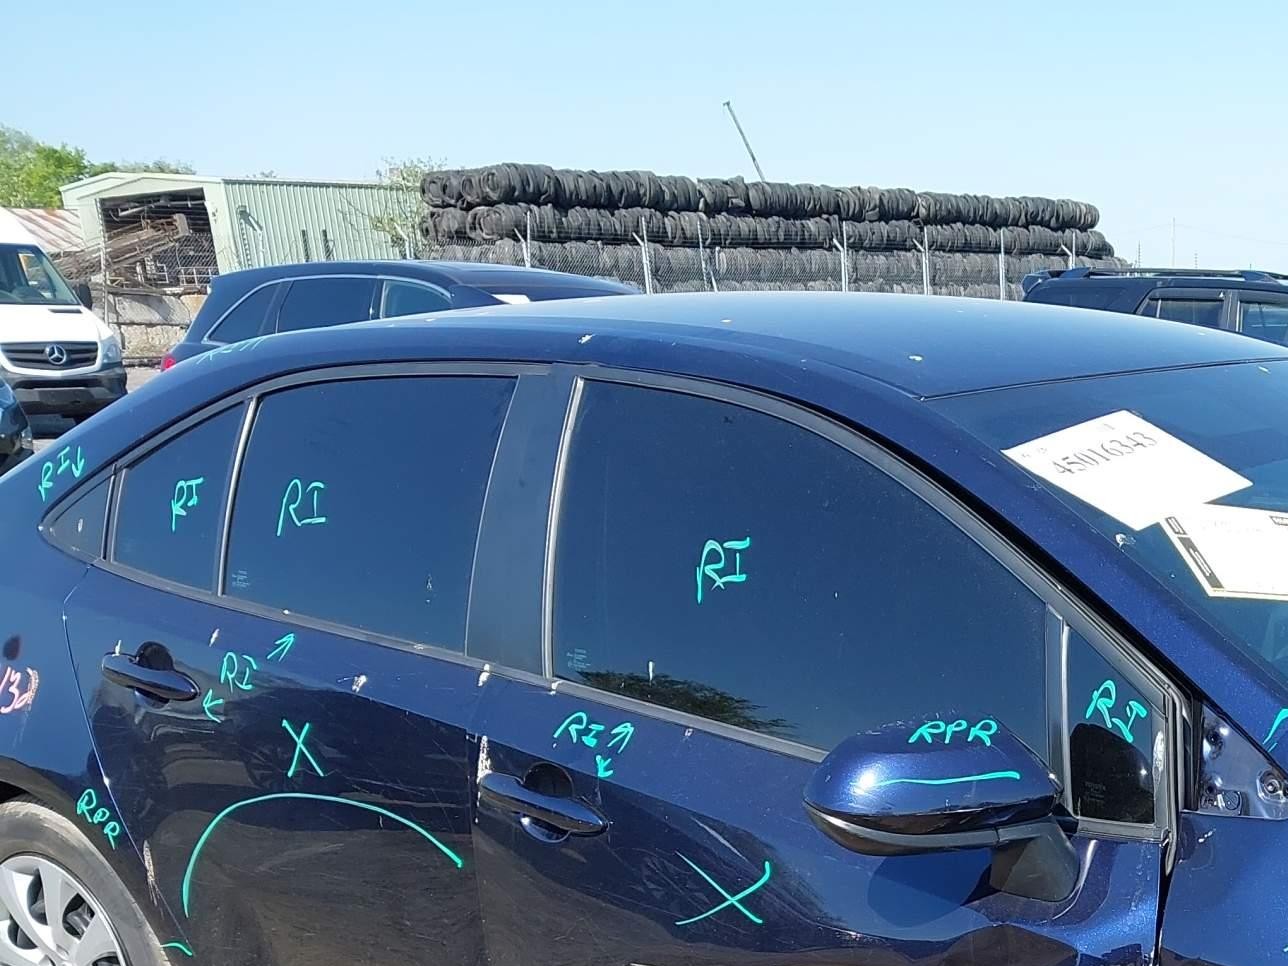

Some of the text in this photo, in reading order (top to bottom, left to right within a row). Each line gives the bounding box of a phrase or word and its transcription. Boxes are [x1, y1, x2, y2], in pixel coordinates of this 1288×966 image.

[1052, 431, 1158, 475] 45016343
[172, 475, 206, 533] RI
[276, 478, 327, 537] RI
[696, 537, 751, 603] RI
[908, 718, 999, 747] RPR
[76, 789, 122, 850] RPR
